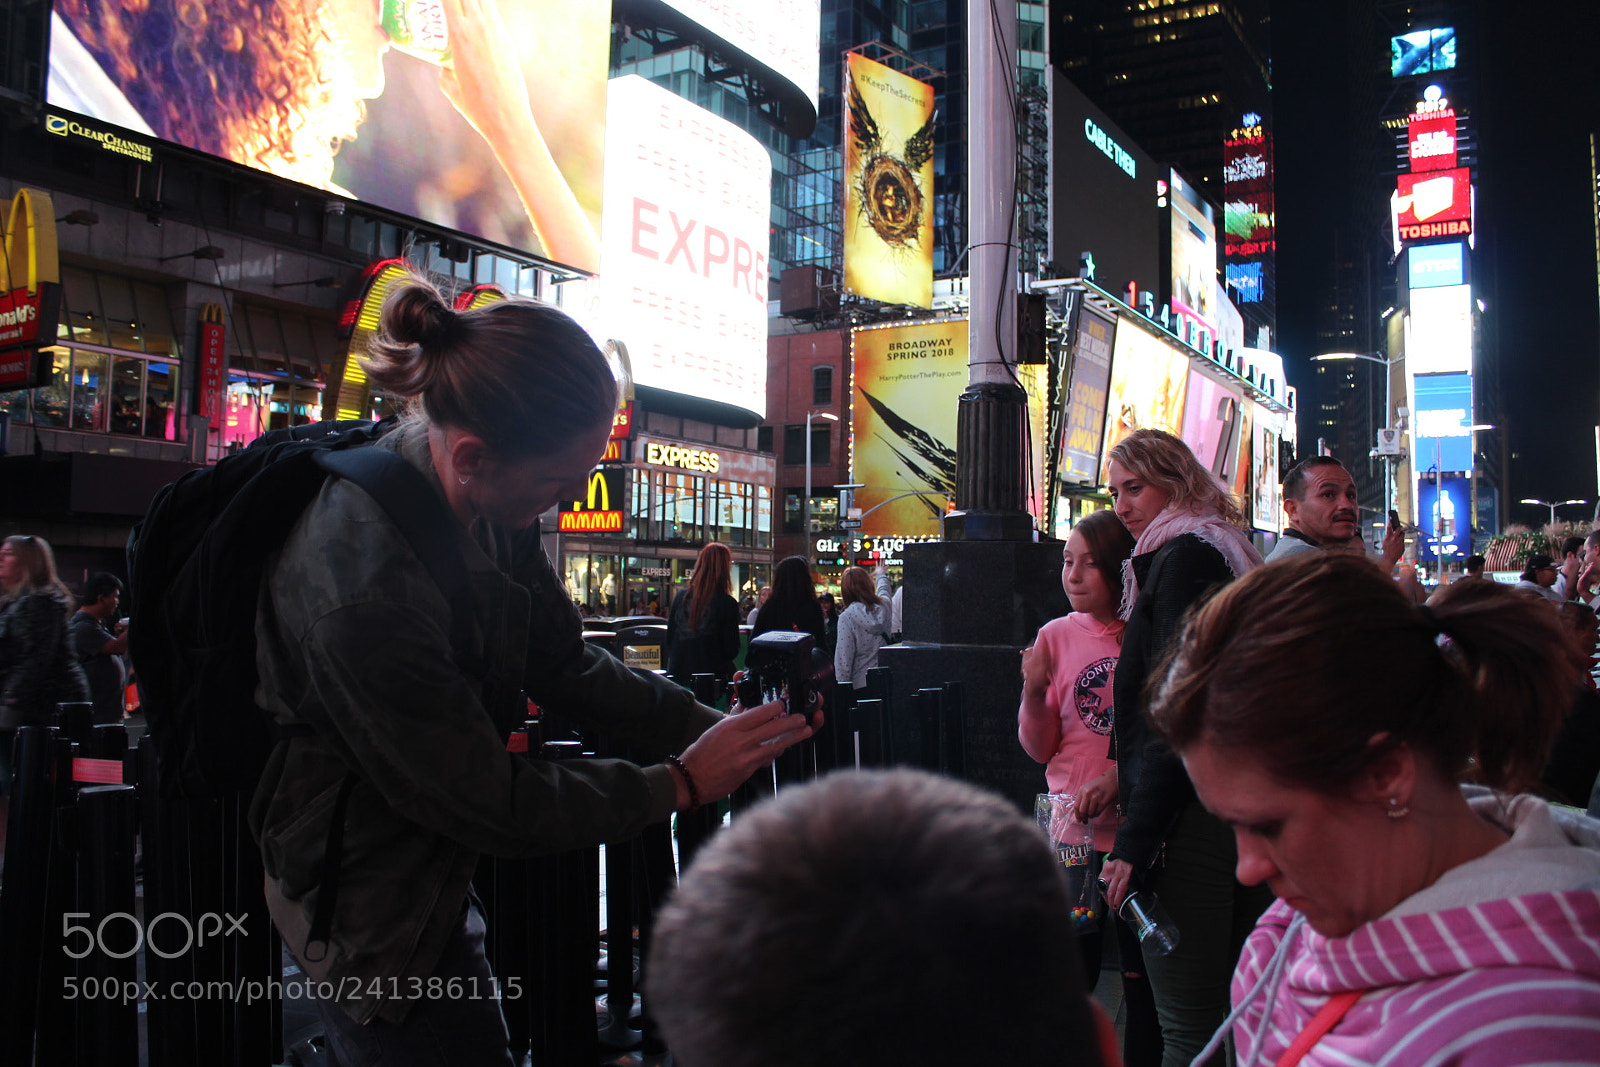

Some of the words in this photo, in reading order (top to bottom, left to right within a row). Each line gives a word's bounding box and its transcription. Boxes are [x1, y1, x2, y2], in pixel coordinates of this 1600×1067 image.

[1408, 109, 1455, 122] TOSHIBA
[1085, 118, 1114, 160] CABLE
[102, 142, 152, 162] SPECTACOLOR
[1399, 220, 1471, 240] TOSHIBA
[887, 350, 927, 361] SPRING
[931, 347, 955, 358] 2018
[889, 338, 953, 351] BROADWAY
[879, 370, 962, 382] HarryPotterThePlay.com
[1074, 381, 1105, 411] COME
[1068, 426, 1101, 454] AWAY
[647, 442, 720, 474] EXPRESS
[641, 567, 672, 577] EXPRESS
